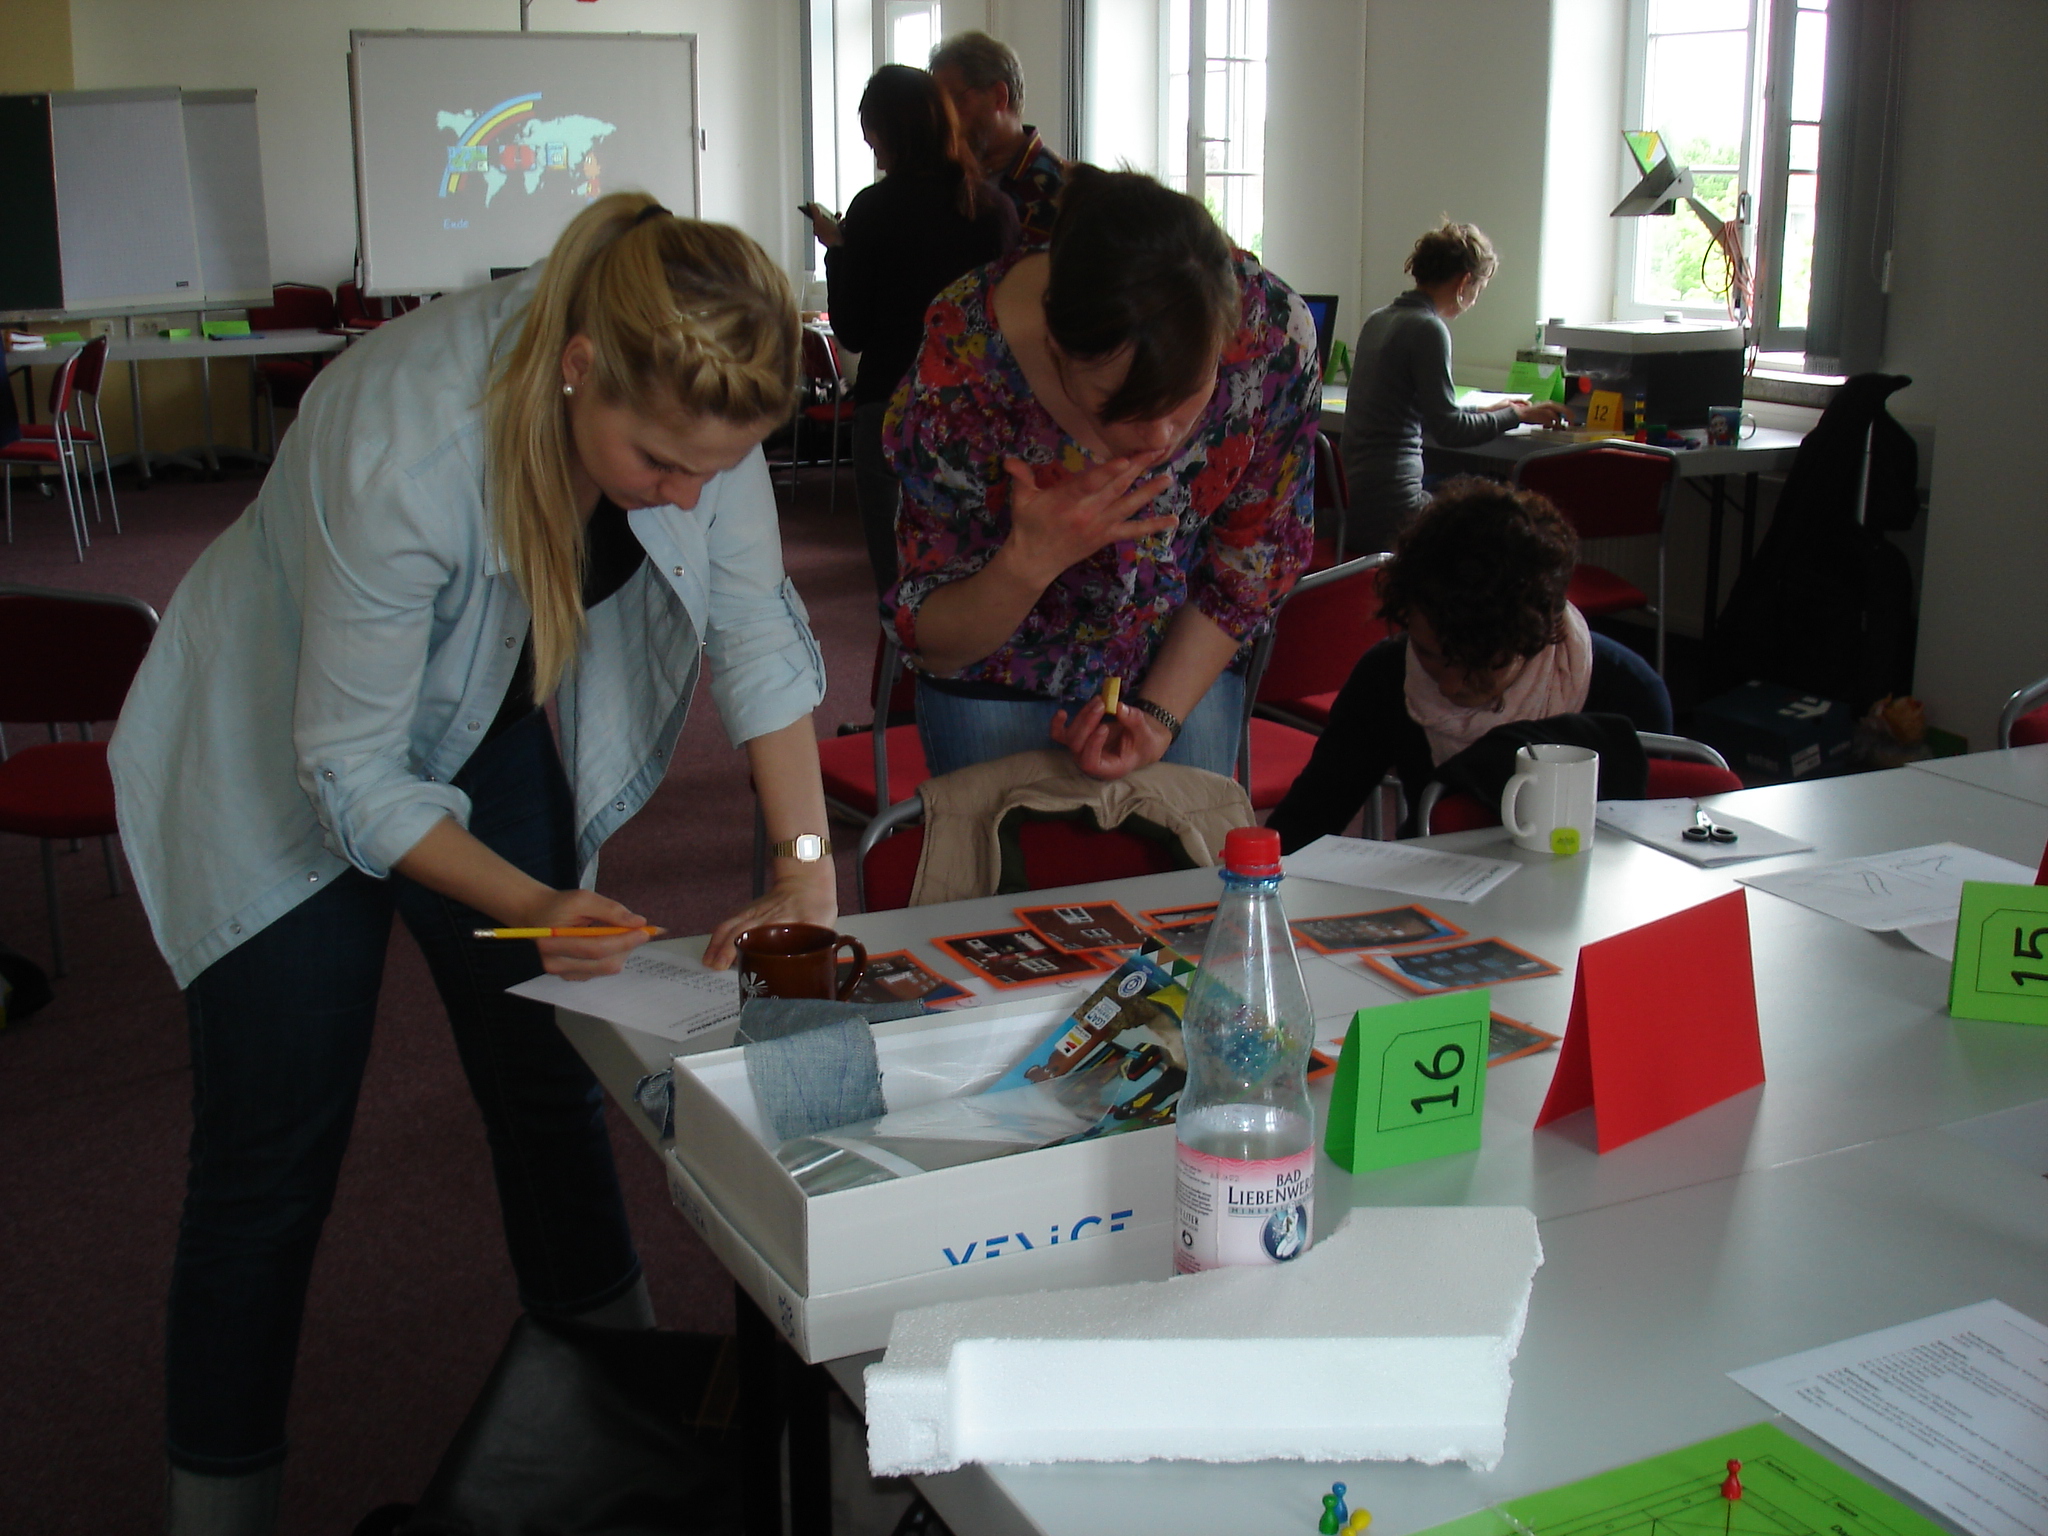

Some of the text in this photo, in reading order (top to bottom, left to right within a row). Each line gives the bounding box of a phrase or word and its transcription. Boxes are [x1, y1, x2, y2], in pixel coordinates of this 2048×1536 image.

[443, 218, 470, 230] Ende
[1594, 405, 1609, 421] 12
[2011, 927, 2048, 986] 15
[1411, 1043, 1465, 1114] 16
[1276, 1169, 1301, 1187] BAD
